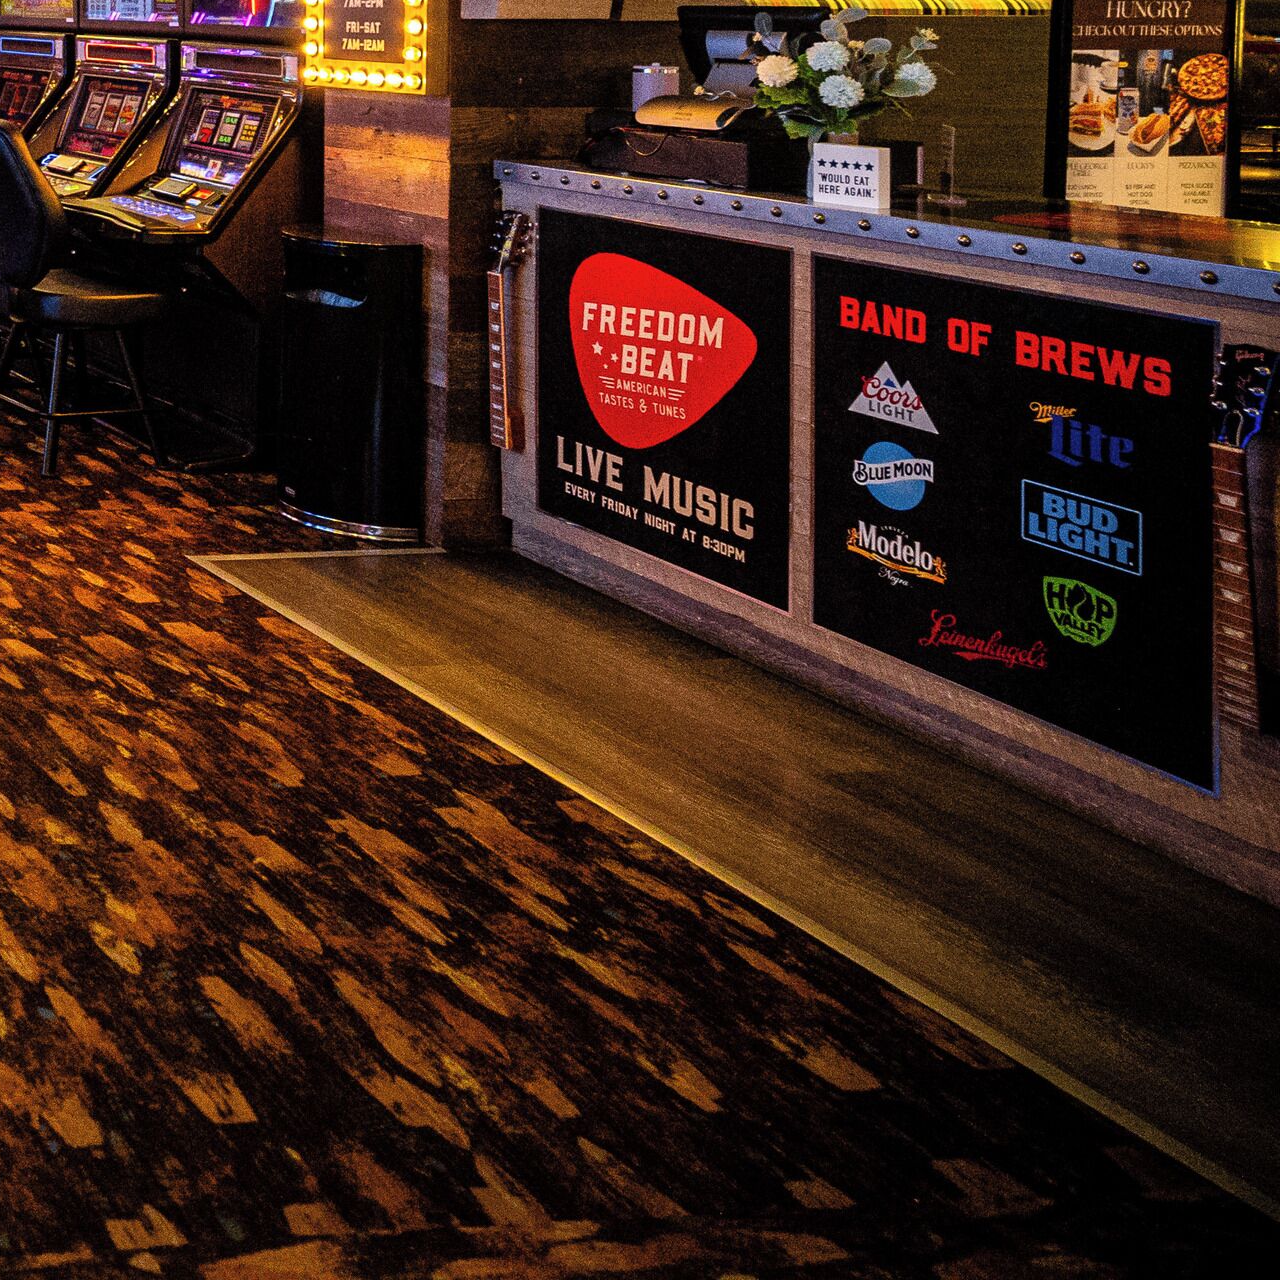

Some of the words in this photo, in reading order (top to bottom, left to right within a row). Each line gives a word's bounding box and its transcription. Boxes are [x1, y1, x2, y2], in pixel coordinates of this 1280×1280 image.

[1106, 0, 1192, 20] HUNGRY?
[345, 21, 381, 34] FRI-SAT
[1072, 24, 1112, 37] CHECK
[1113, 24, 1137, 37] OUT
[1139, 24, 1174, 37] THESE
[1175, 23, 1223, 37] OPTIONS
[342, 38, 385, 52] 7AM-12AM
[819, 184, 841, 195] HERE
[854, 176, 870, 186] EAT
[582, 302, 724, 349] FREEDOM
[840, 295, 927, 344] BAND
[947, 317, 992, 357] OF
[1016, 330, 1171, 397] BREWS
[621, 344, 694, 383] BEAT
[616, 378, 667, 398] AMERICAN
[861, 375, 923, 410] Coors
[599, 392, 634, 410] TASTES
[639, 398, 648, 413] &
[653, 402, 686, 420] TUNES
[868, 400, 915, 422] LIGHT
[1029, 401, 1077, 422] Miller
[1048, 416, 1134, 468] Lite
[854, 462, 890, 483] BLUE
[894, 462, 932, 478] MOON
[557, 435, 623, 492] LIVE
[644, 465, 754, 540] MUSIC
[565, 482, 595, 503] EVERY
[601, 496, 638, 520] FRIDAY
[645, 512, 676, 536] NIGHT
[682, 529, 697, 543] AT
[703, 535, 746, 563] 8:30PM
[1043, 491, 1119, 533] BUD
[859, 520, 934, 571] Modelo
[1053, 610, 1105, 641] VALLEY
